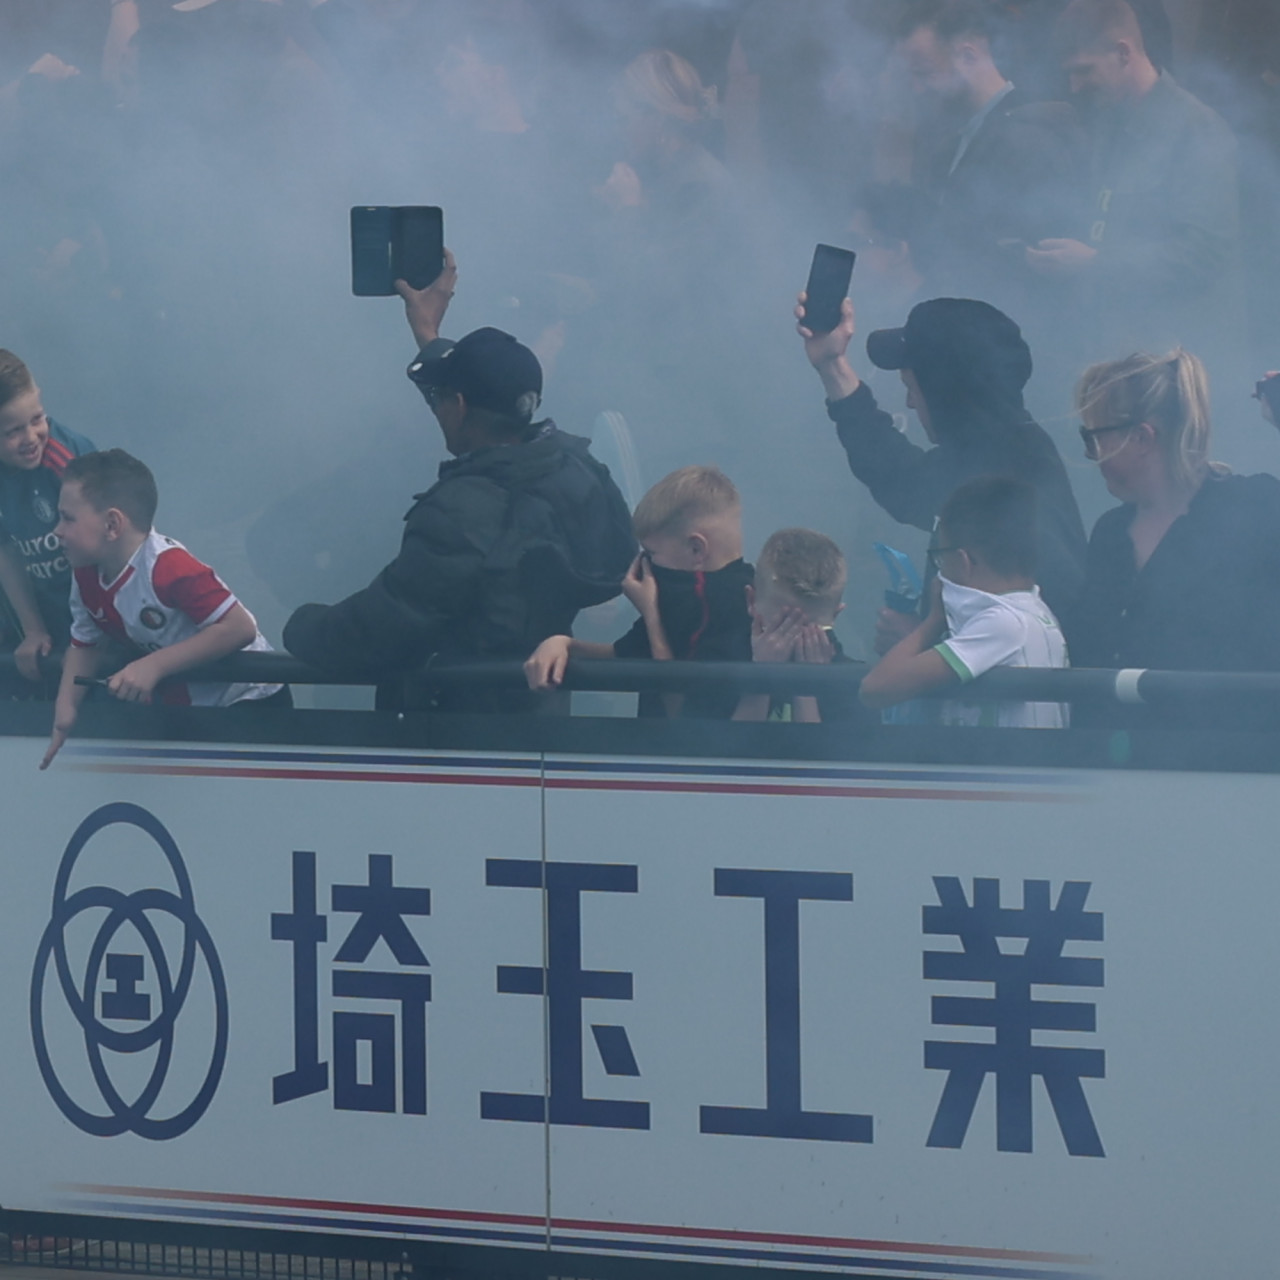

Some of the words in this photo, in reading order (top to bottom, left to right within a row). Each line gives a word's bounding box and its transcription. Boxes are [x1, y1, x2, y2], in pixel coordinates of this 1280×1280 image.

[11, 533, 60, 556] uro
[25, 556, 69, 579] arc
[270, 850, 1106, 1158] 埼玉工業
